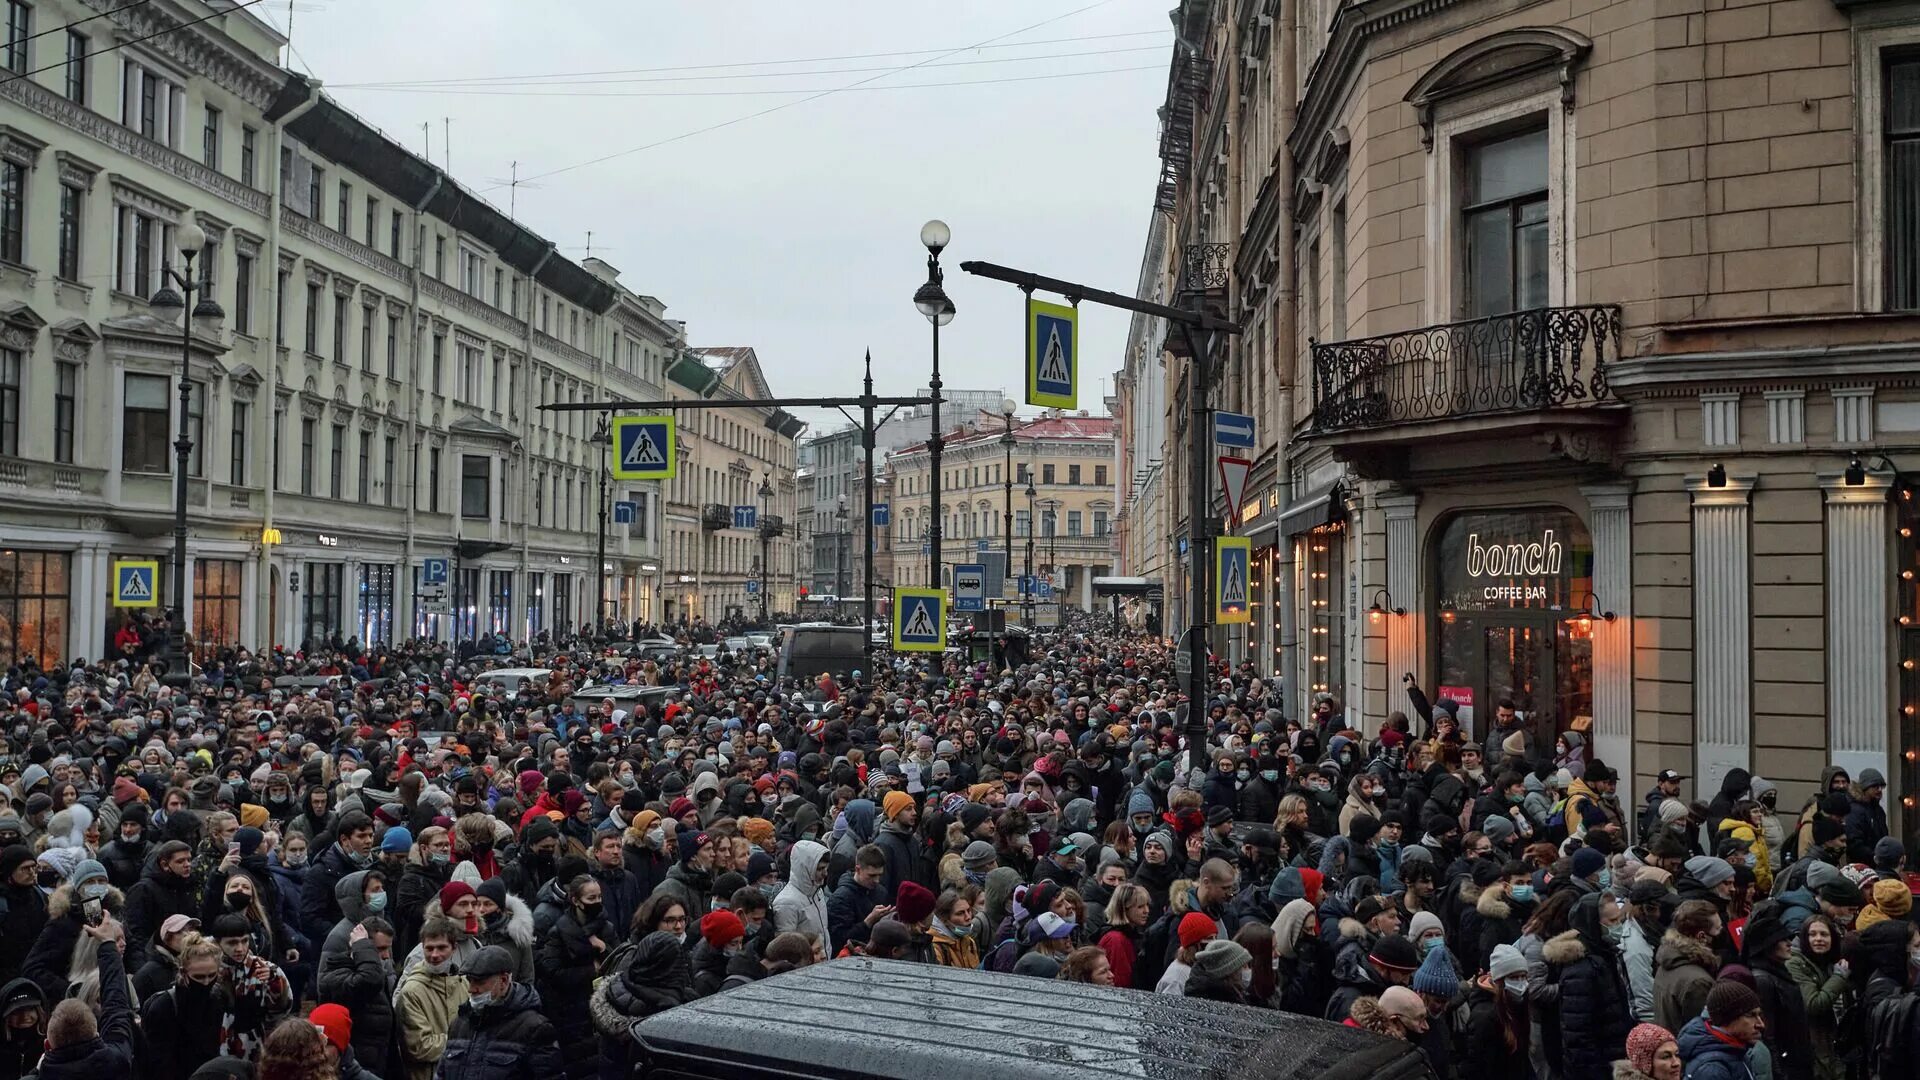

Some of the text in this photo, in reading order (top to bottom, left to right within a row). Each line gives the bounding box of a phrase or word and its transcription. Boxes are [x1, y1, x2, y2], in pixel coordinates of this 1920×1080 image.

[1467, 530, 1562, 576] bonch
[750, 582, 757, 592] P
[1484, 586, 1546, 599] COFFEE BAR
